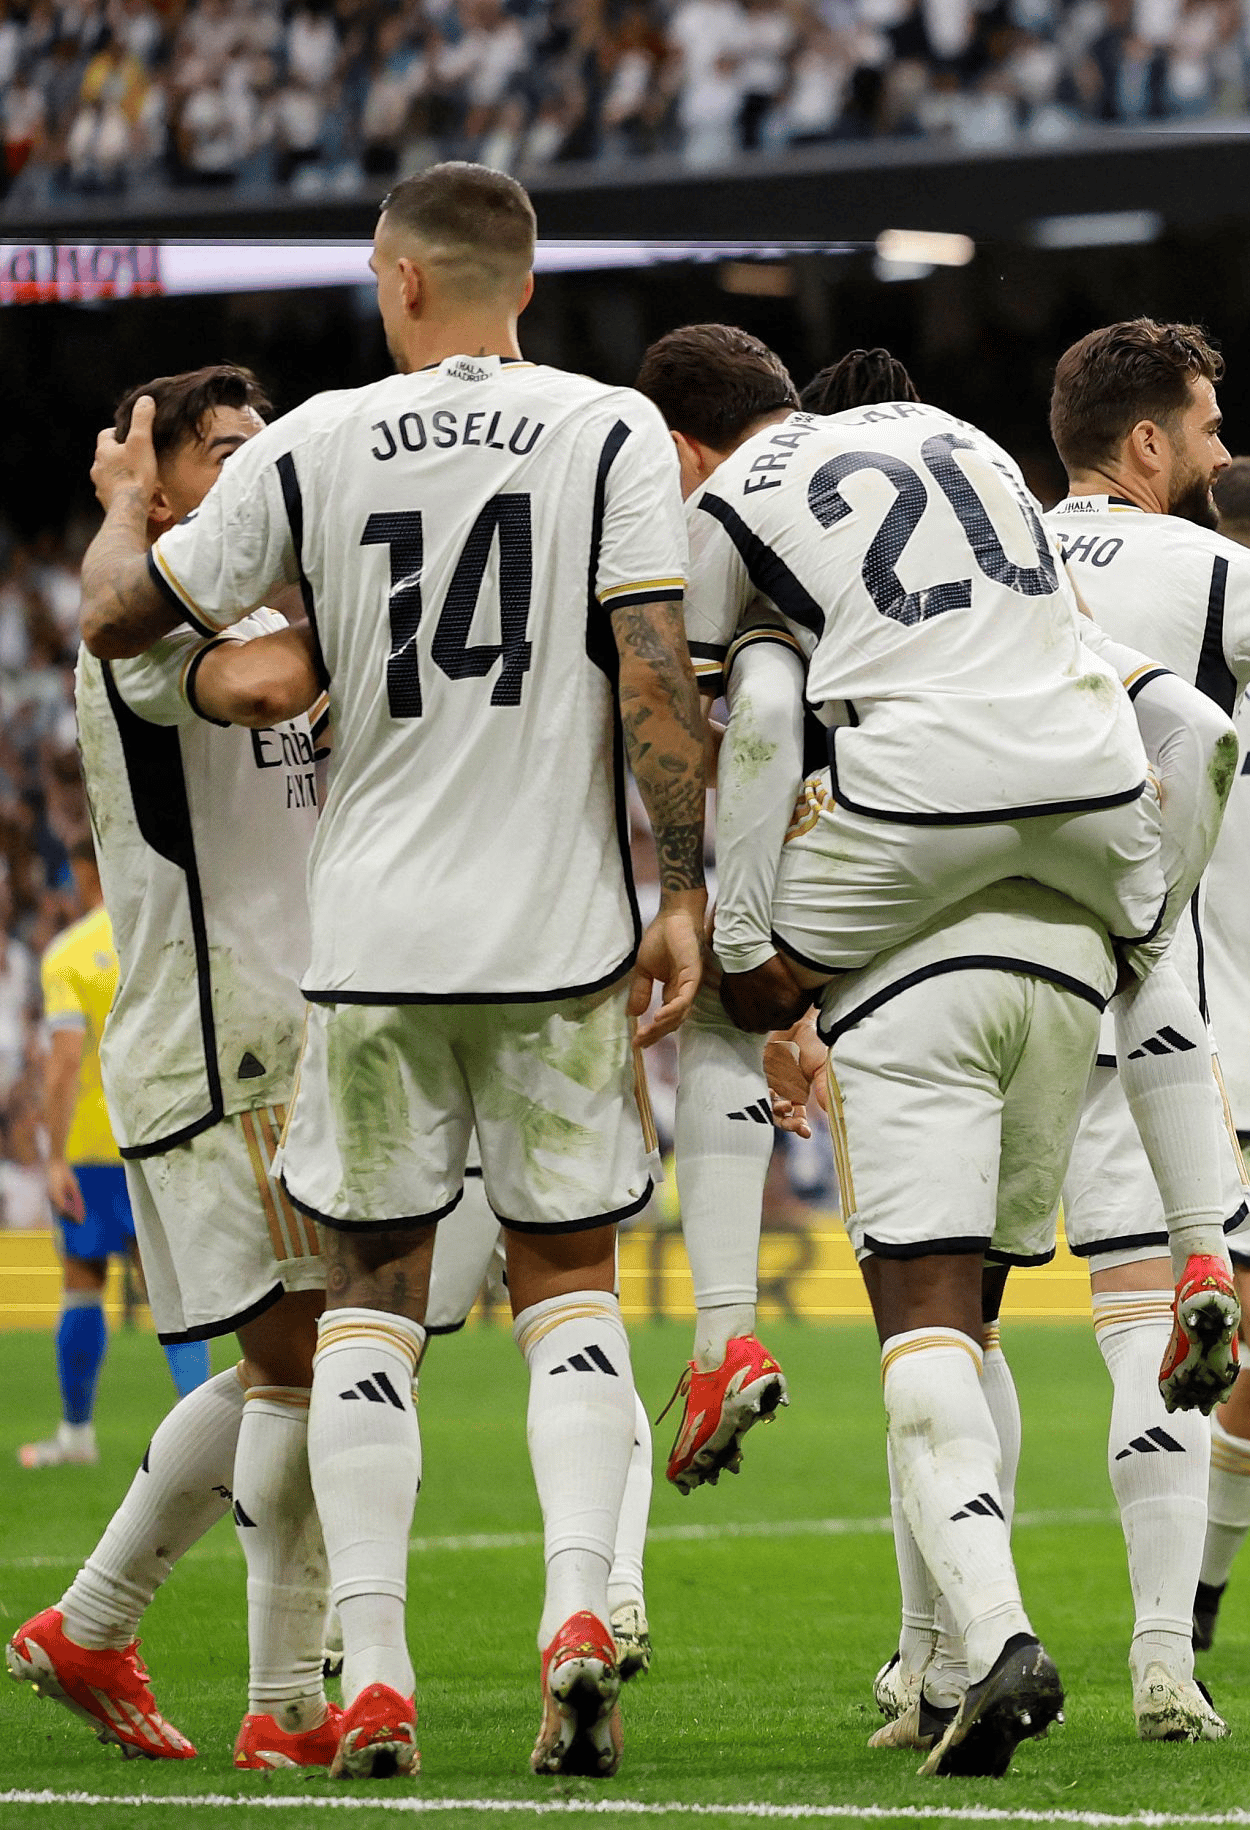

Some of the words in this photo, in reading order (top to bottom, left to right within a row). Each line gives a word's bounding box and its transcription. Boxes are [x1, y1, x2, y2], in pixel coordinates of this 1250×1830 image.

[371, 410, 545, 461] JOSELU
[807, 432, 1060, 627] 20
[360, 492, 532, 718] 14
